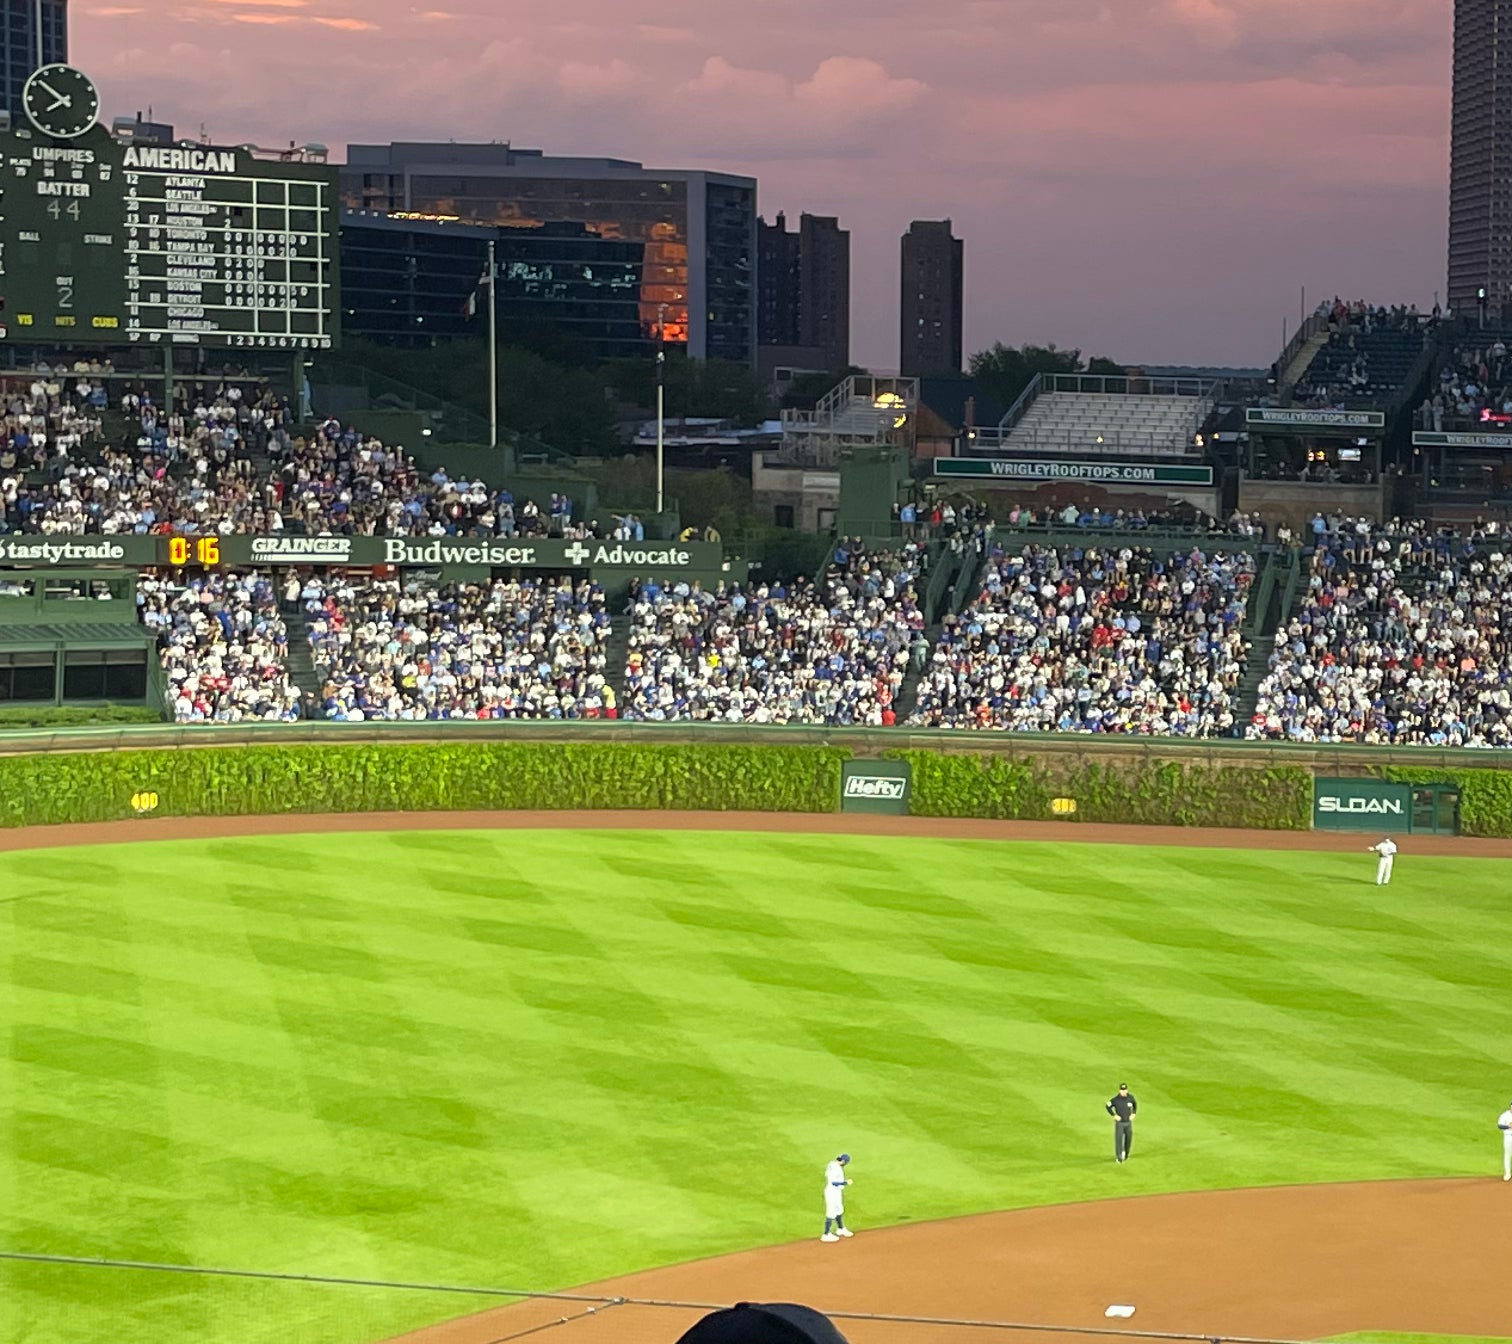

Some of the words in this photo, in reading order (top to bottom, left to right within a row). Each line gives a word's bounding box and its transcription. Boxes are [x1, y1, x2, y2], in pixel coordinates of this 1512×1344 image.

[32, 147, 95, 163] UMPIRES
[123, 147, 235, 172] AMERICAN
[37, 181, 90, 197] BATTER
[126, 174, 138, 185] 12
[165, 177, 206, 189] ATLANTA
[130, 187, 137, 197] 6
[166, 190, 202, 201] SEATTLE
[47, 199, 80, 221] 44
[19, 232, 40, 241] BALL
[130, 254, 137, 264] 2
[167, 255, 215, 266] CLEVELAND
[167, 281, 202, 292] BOSTON
[58, 287, 73, 308] 2
[227, 335, 232, 345] 1
[236, 336, 244, 345] 2
[248, 336, 254, 346] 3
[258, 337, 266, 346] 4
[269, 337, 276, 347] 5
[279, 337, 286, 347] 6
[291, 338, 298, 348] 7
[301, 338, 308, 348] 8
[311, 338, 318, 348] 9
[991, 462, 1155, 480] WRIGLEYROOFTOPS.COM
[8, 540, 124, 563] tastytrade
[169, 537, 219, 564] 0:16
[251, 538, 350, 554] GRAINGER
[384, 540, 532, 564] Budweiser
[594, 545, 689, 565] Advocate
[849, 780, 901, 796] Hefty
[1318, 796, 1401, 814] SLOAN
